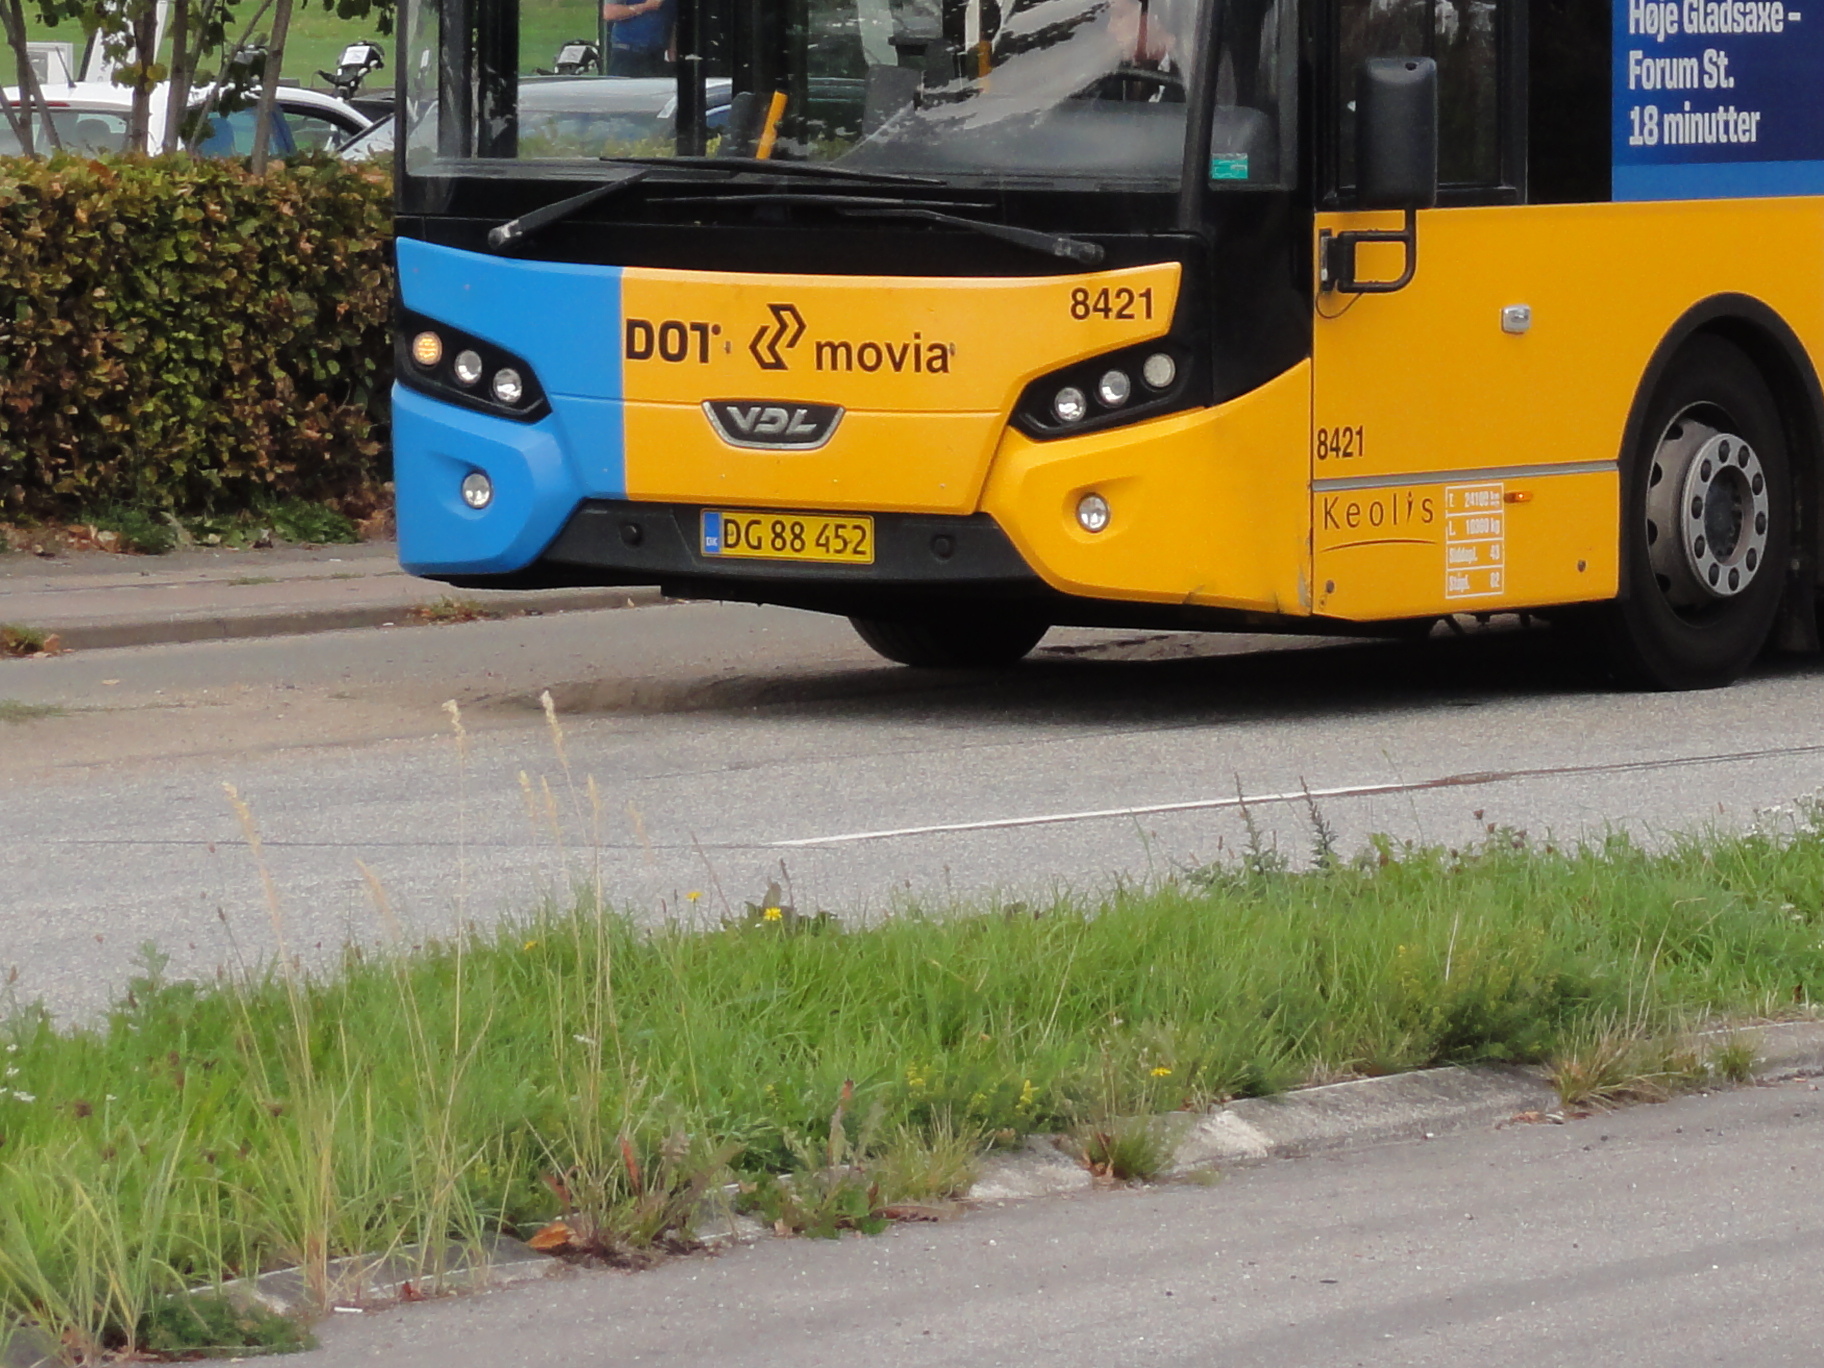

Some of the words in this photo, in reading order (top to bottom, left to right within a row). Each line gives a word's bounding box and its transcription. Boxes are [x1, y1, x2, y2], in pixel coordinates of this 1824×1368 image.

[1629, 50, 1699, 90] Forum
[1703, 48, 1735, 89] St.
[1629, 105, 1659, 146] 18
[1663, 100, 1761, 145] minutter
[1070, 287, 1152, 320] 8421
[626, 318, 721, 364] DOT
[815, 332, 950, 373] movia
[726, 406, 817, 435] VDL
[1317, 425, 1363, 460] 8421
[1324, 491, 1434, 530] Keolis
[724, 518, 762, 550] DG
[771, 520, 806, 553] 88
[815, 523, 867, 555] 452
